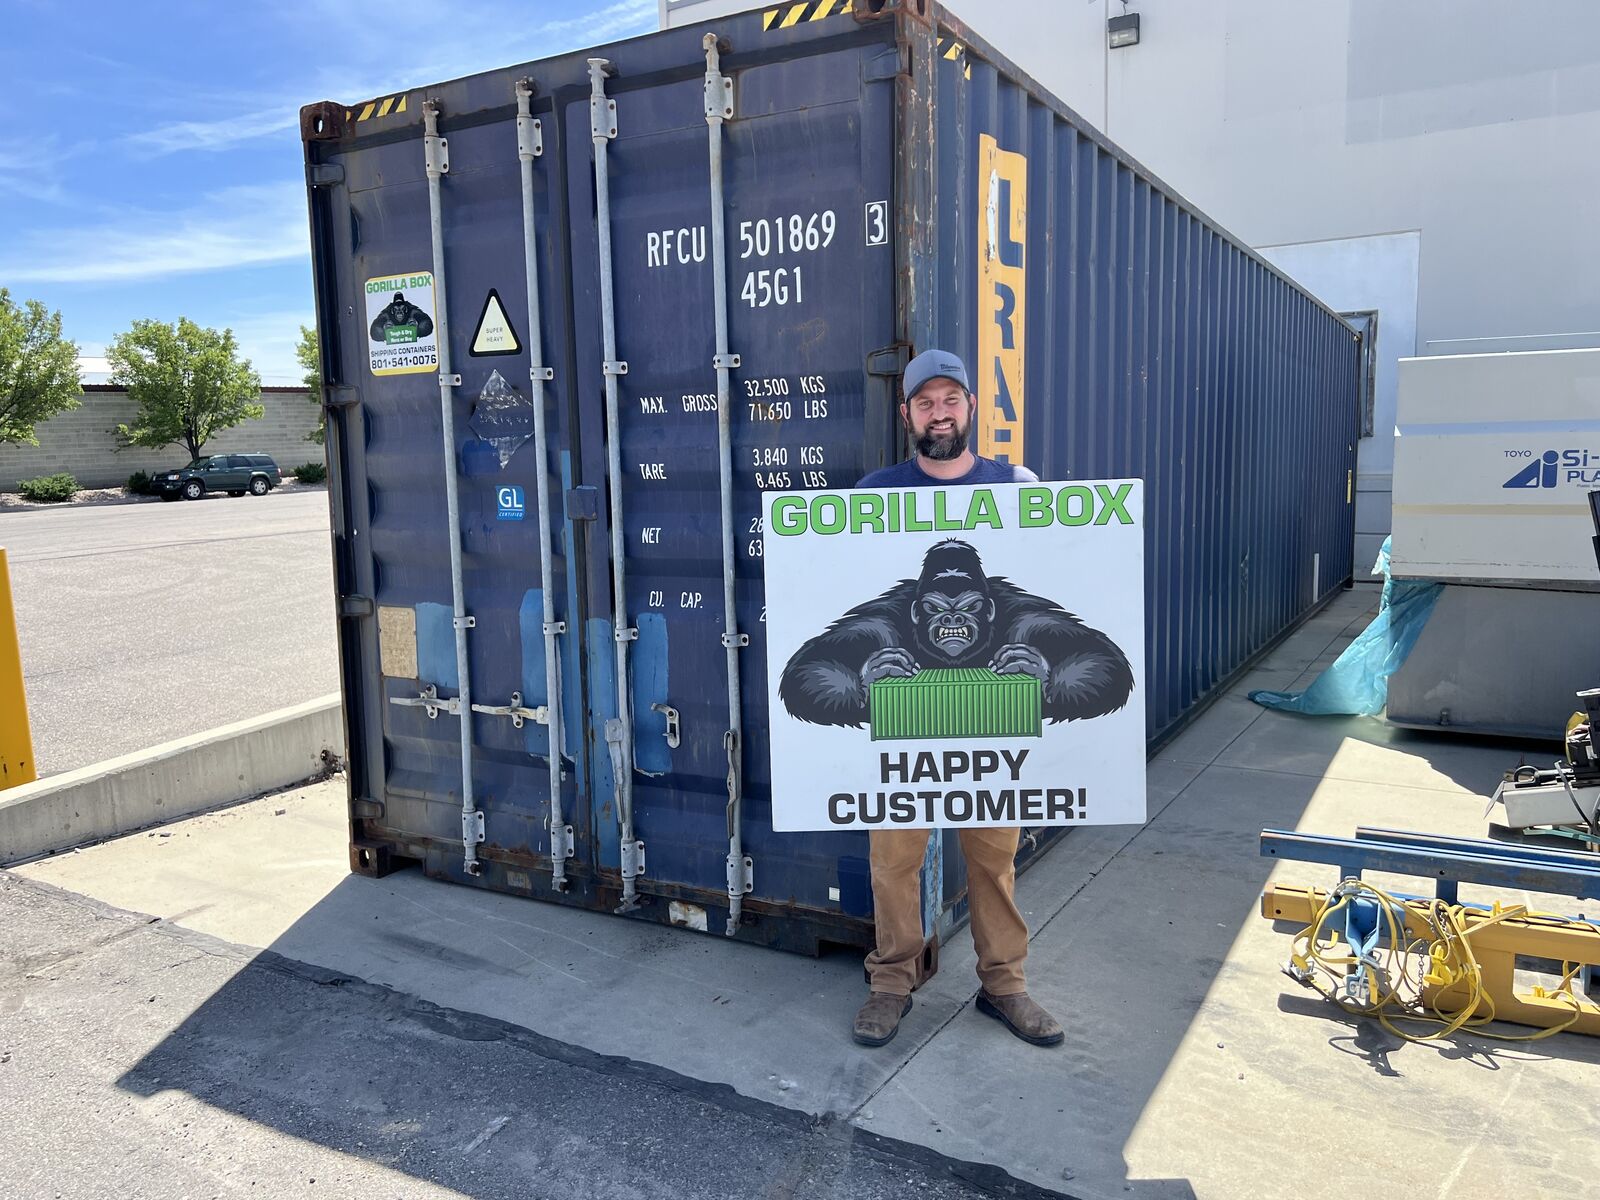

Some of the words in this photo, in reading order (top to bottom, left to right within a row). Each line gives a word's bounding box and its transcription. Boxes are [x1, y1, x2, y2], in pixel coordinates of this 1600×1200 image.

[647, 225, 706, 267] RFCU
[740, 210, 836, 259] 501869
[868, 203, 884, 243] 3
[366, 278, 408, 294] GORILLA
[409, 275, 432, 288] BOX
[740, 266, 802, 308] 45G1
[485, 326, 503, 334] SUPER
[371, 348, 397, 358] SHIPPING
[398, 345, 436, 355] CONTAINERS
[800, 375, 826, 394] KGS
[640, 396, 668, 414] MAX.
[681, 393, 718, 412] GROSS
[804, 399, 828, 419] LBS
[800, 446, 824, 465] KGS
[639, 463, 667, 480] TARE
[802, 471, 828, 488] LBS
[498, 488, 522, 508] GL
[770, 488, 1003, 536] GORILLA
[1018, 483, 1134, 529] BOX
[641, 527, 662, 544] NET
[649, 591, 665, 608] CU.
[680, 591, 704, 609] CAP.
[879, 748, 1030, 785] HAPPY
[827, 787, 1087, 825] CUSTOMER!
